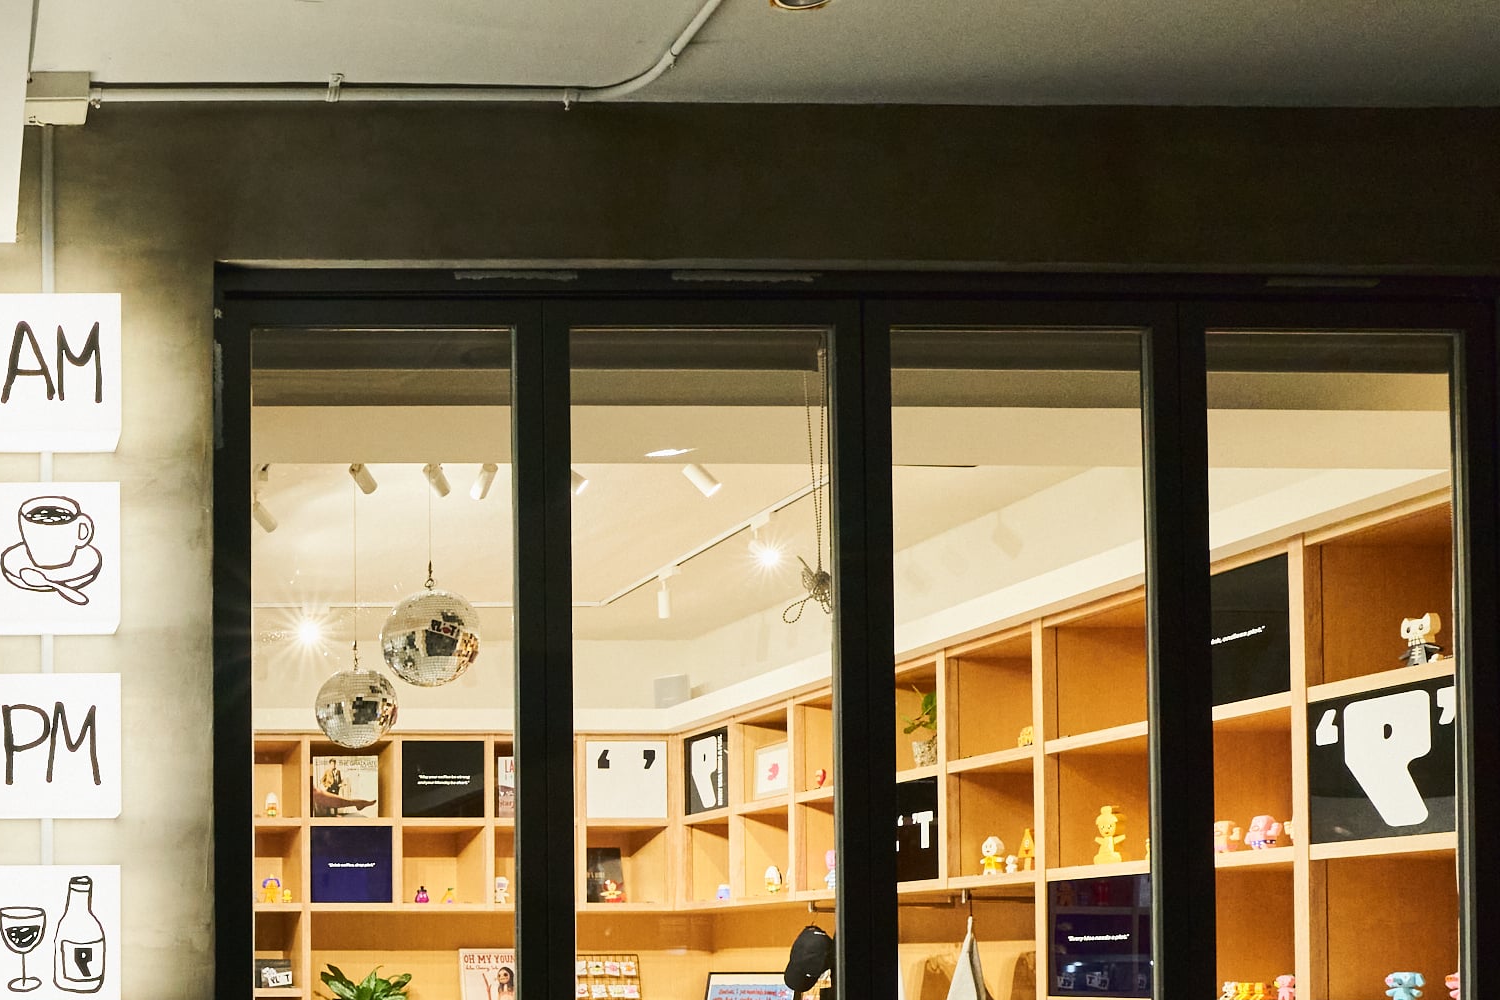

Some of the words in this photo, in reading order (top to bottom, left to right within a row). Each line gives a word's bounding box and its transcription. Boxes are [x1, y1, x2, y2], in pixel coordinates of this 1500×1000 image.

[0, 320, 102, 404] AM
[2, 701, 102, 786] PM
[463, 954, 475, 964] OH
[477, 954, 491, 964] MY
